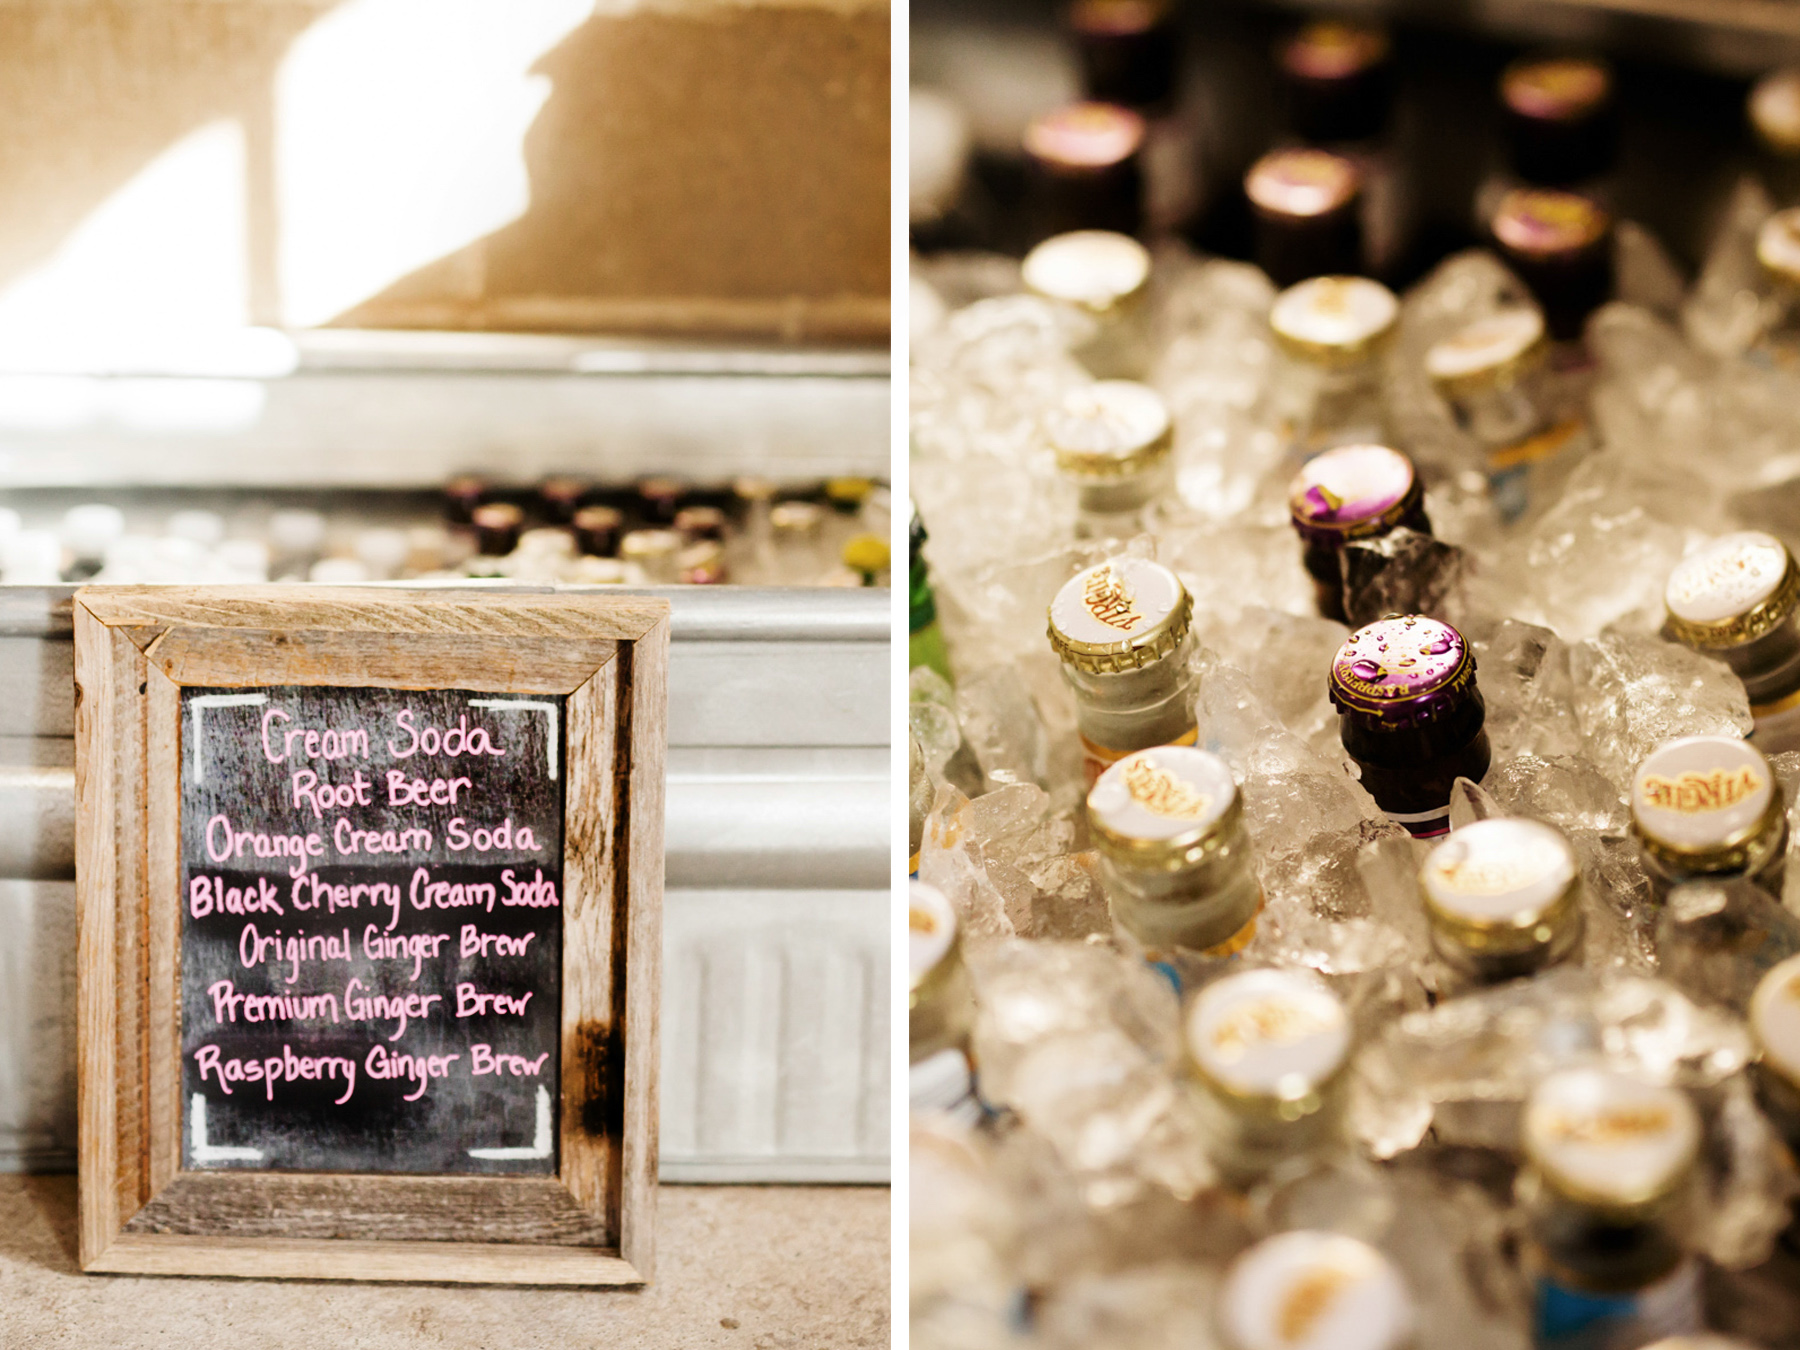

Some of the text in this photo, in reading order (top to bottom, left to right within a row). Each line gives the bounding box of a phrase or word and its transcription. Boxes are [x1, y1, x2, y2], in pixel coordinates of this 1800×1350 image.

[261, 708, 506, 764] Cream Soda
[292, 768, 473, 819] Root Beer
[205, 814, 543, 879] Orange Cream Soda
[189, 867, 561, 930] Black Cherry Cream Soda
[239, 922, 537, 985] Original Ginger Brew
[207, 977, 533, 1042] Premium Ginger Brew
[194, 1043, 550, 1105] Raspberry Ginger Brew
